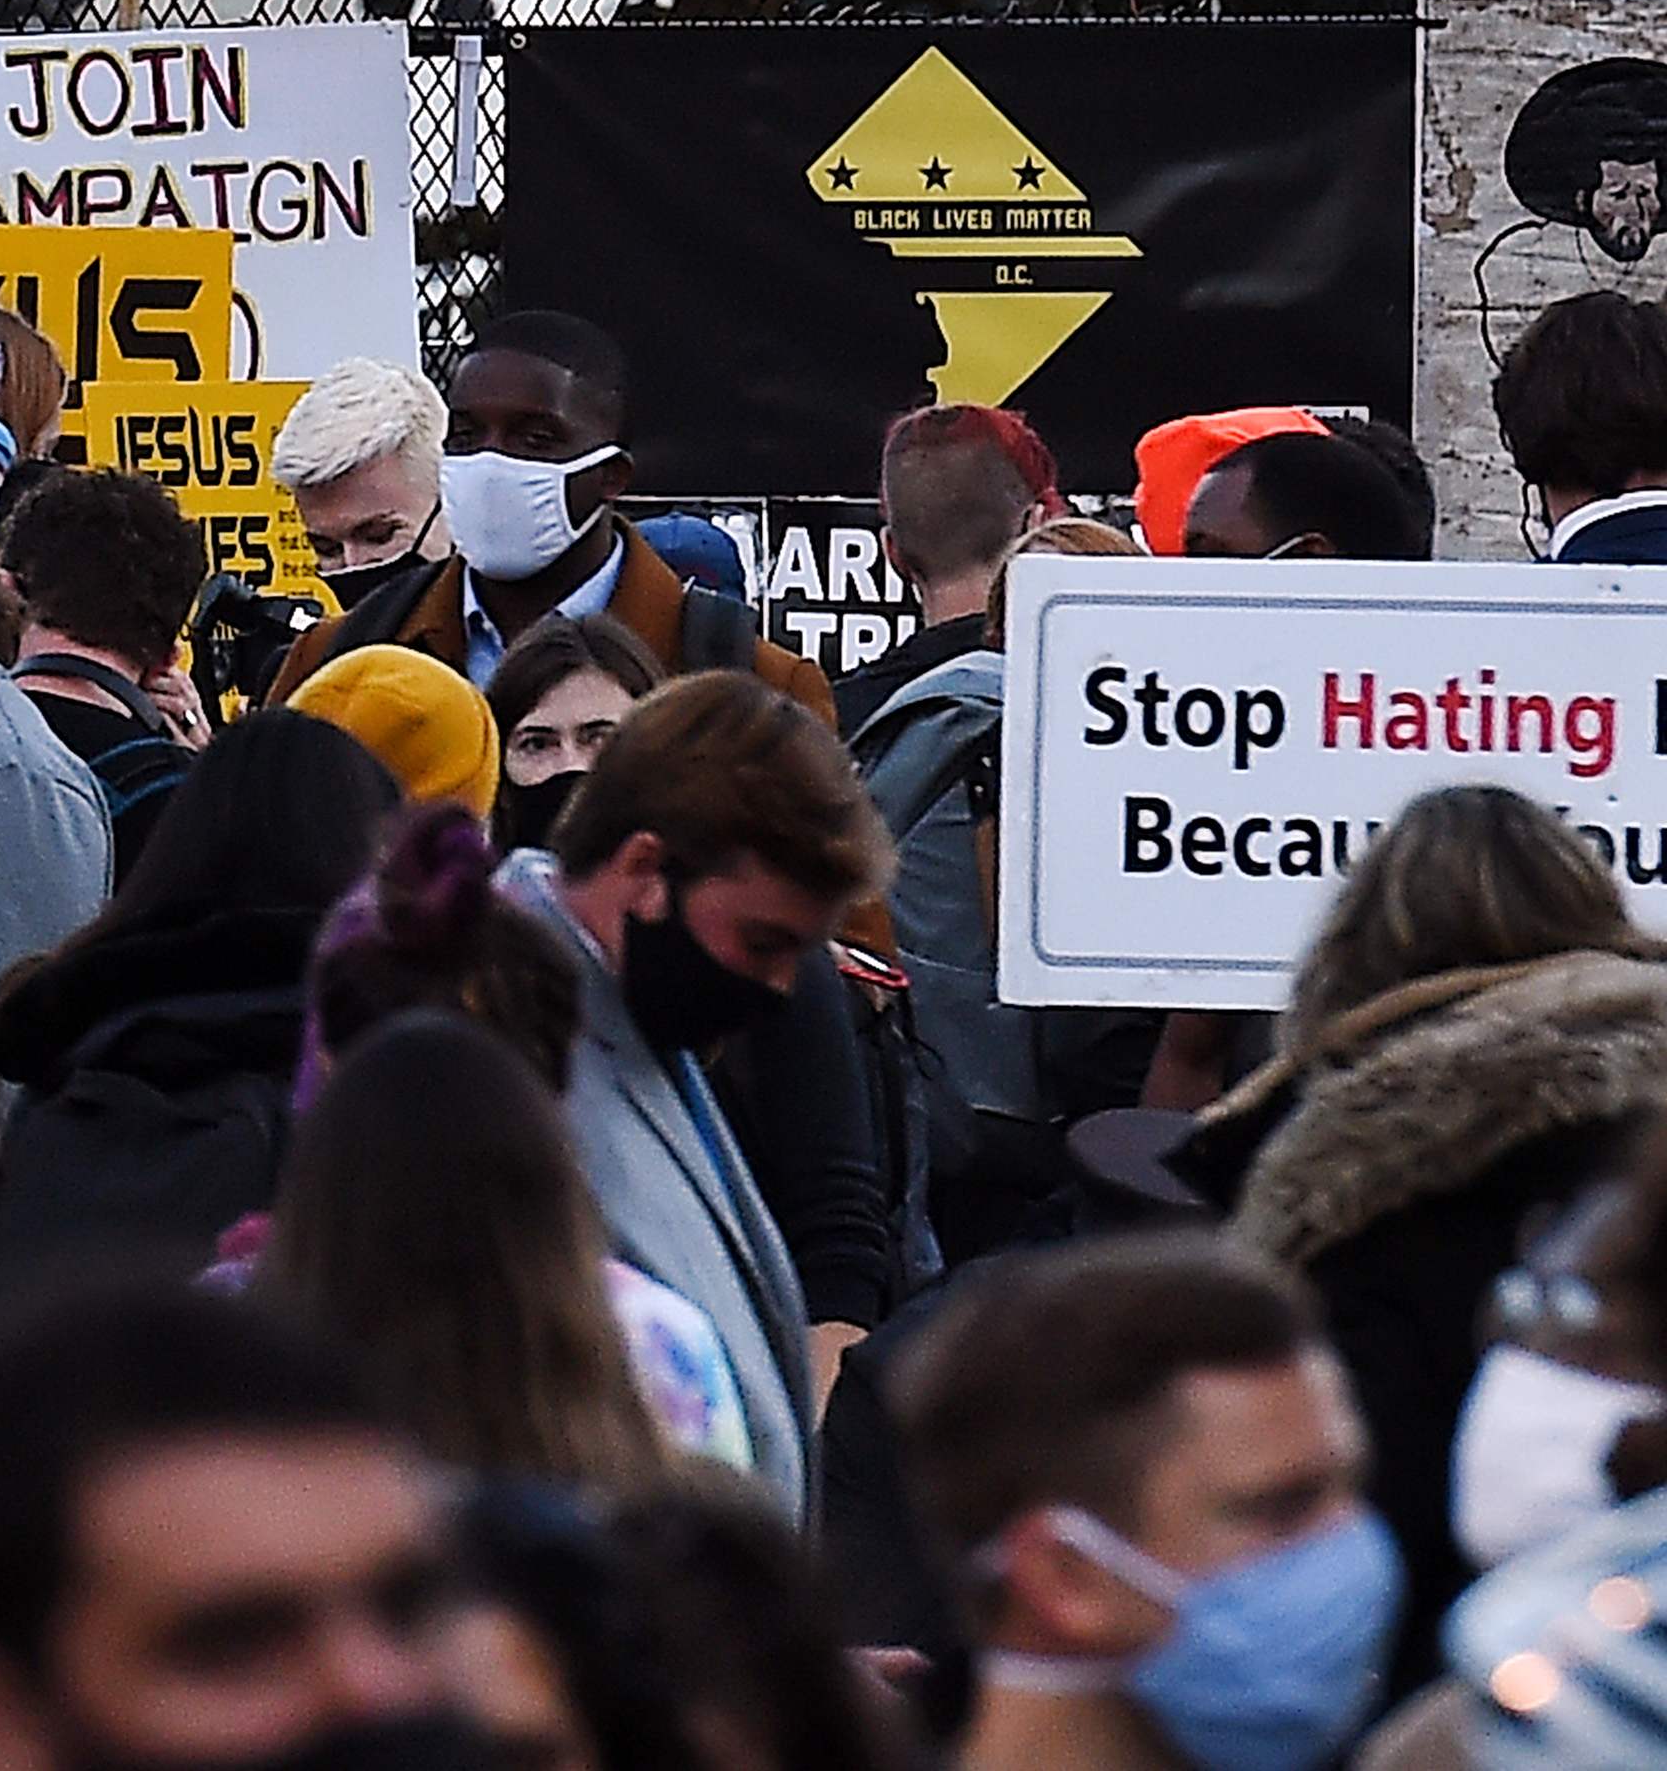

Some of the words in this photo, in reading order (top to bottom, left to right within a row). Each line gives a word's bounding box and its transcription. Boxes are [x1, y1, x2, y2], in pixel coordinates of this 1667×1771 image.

[5, 46, 244, 140] JOIN
[854, 208, 919, 230] BLACK
[933, 208, 993, 230] LIVES
[1006, 208, 1091, 230] MATTER
[1083, 666, 1286, 770] Stop
[1322, 669, 1615, 777] Hating
[1122, 795, 1381, 878] Becau
